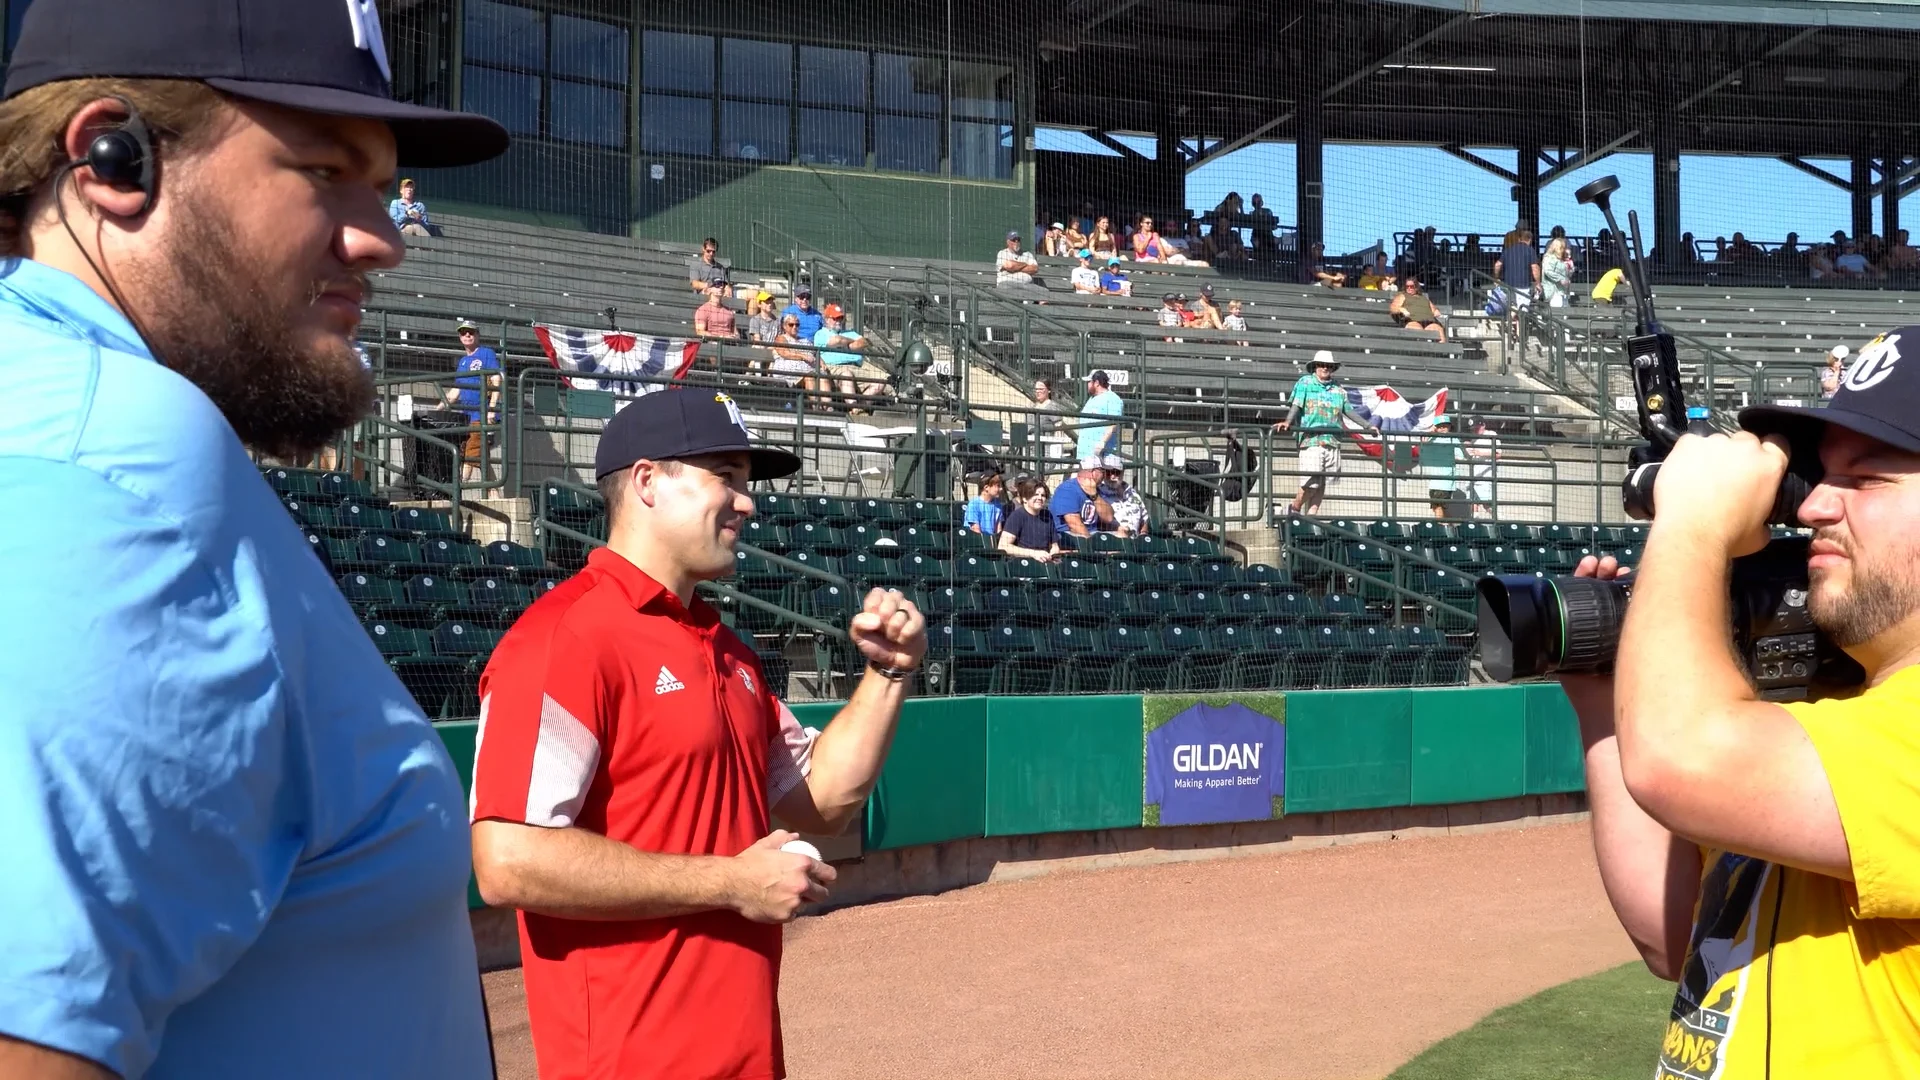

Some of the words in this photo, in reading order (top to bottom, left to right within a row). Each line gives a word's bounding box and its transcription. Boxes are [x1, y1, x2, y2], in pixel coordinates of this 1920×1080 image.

[655, 681, 685, 695] adidas
[1174, 778, 1203, 789] Making
[1205, 776, 1235, 788] Apparel
[1237, 776, 1260, 786] Better
